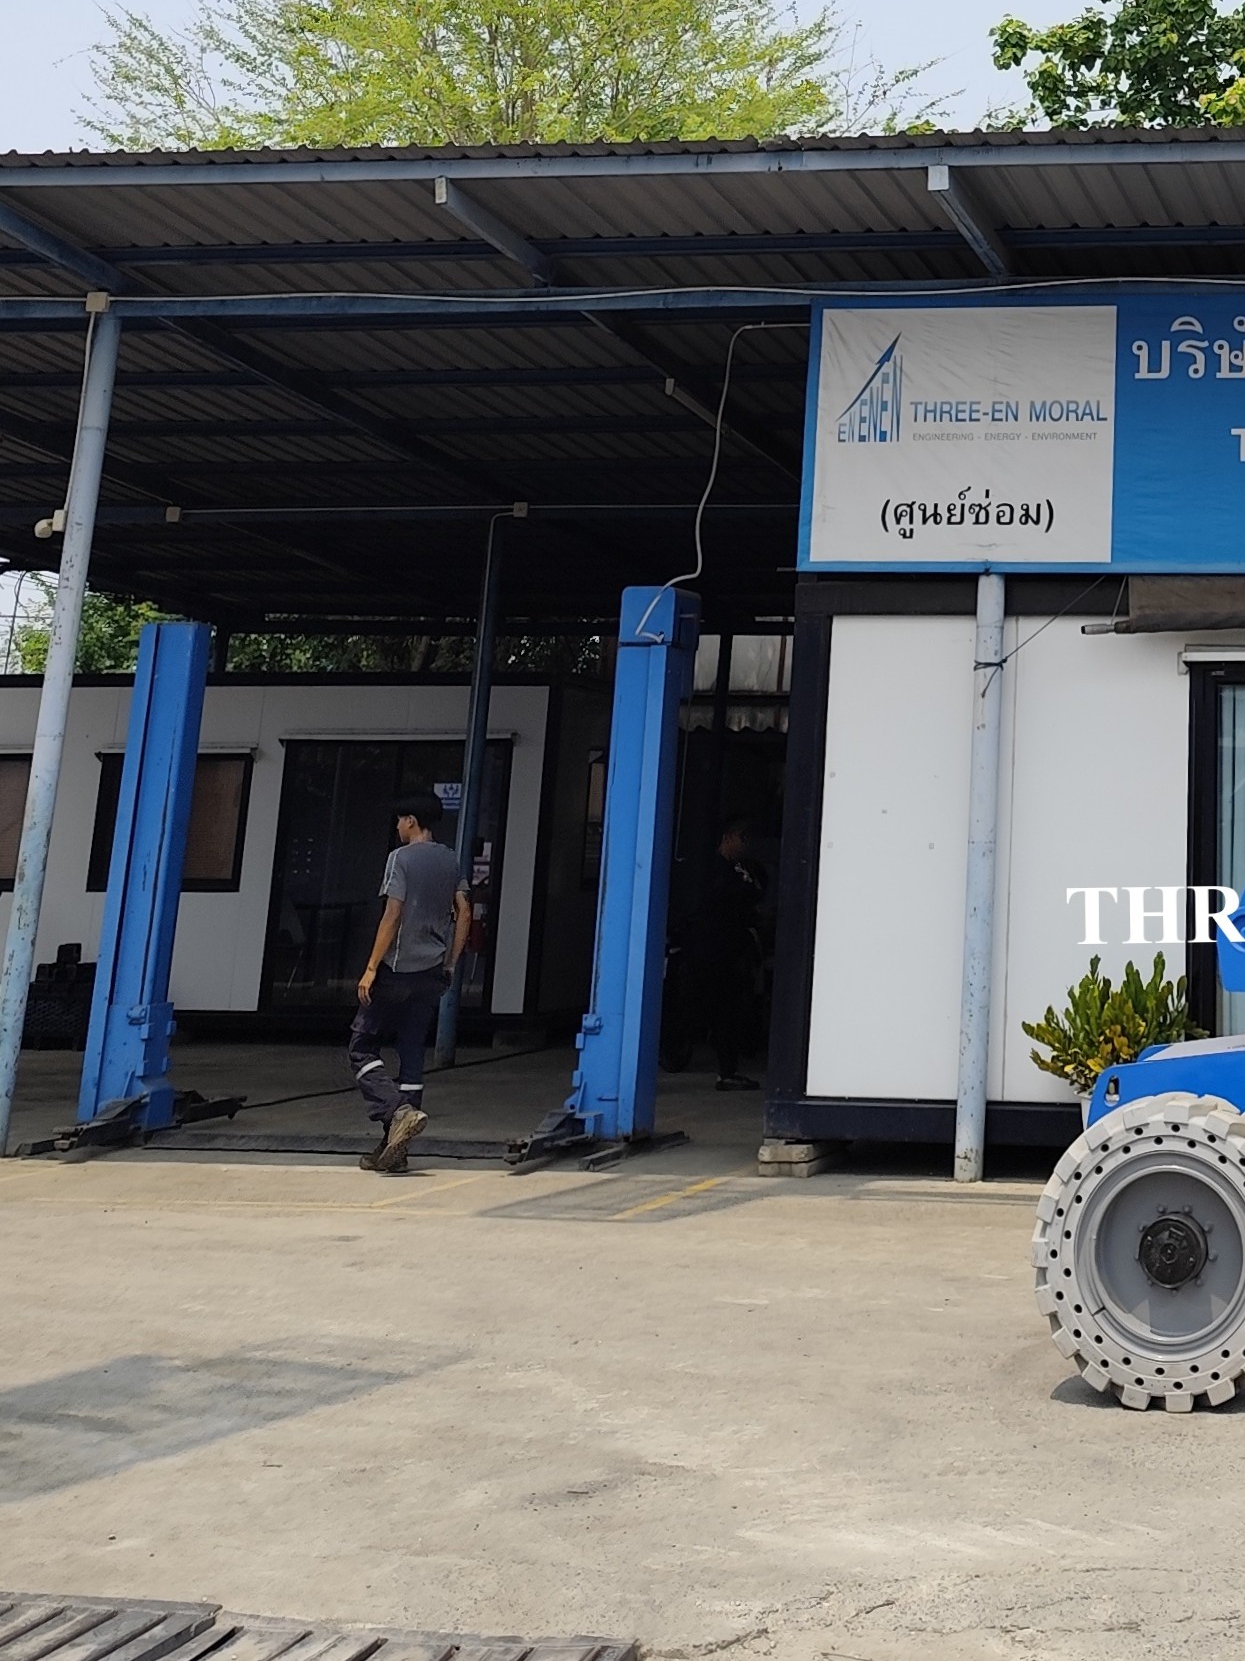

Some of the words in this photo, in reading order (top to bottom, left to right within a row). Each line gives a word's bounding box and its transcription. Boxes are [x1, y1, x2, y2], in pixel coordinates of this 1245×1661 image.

[910, 401, 1020, 423] THREE-EN
[1028, 400, 1109, 422] MORAL
[912, 432, 975, 442] ENGINEERING
[983, 432, 1022, 442] ENERGY
[1031, 431, 1098, 441] ENVIRONMENT
[880, 485, 1055, 540] (ศูนย์ซ่อม)
